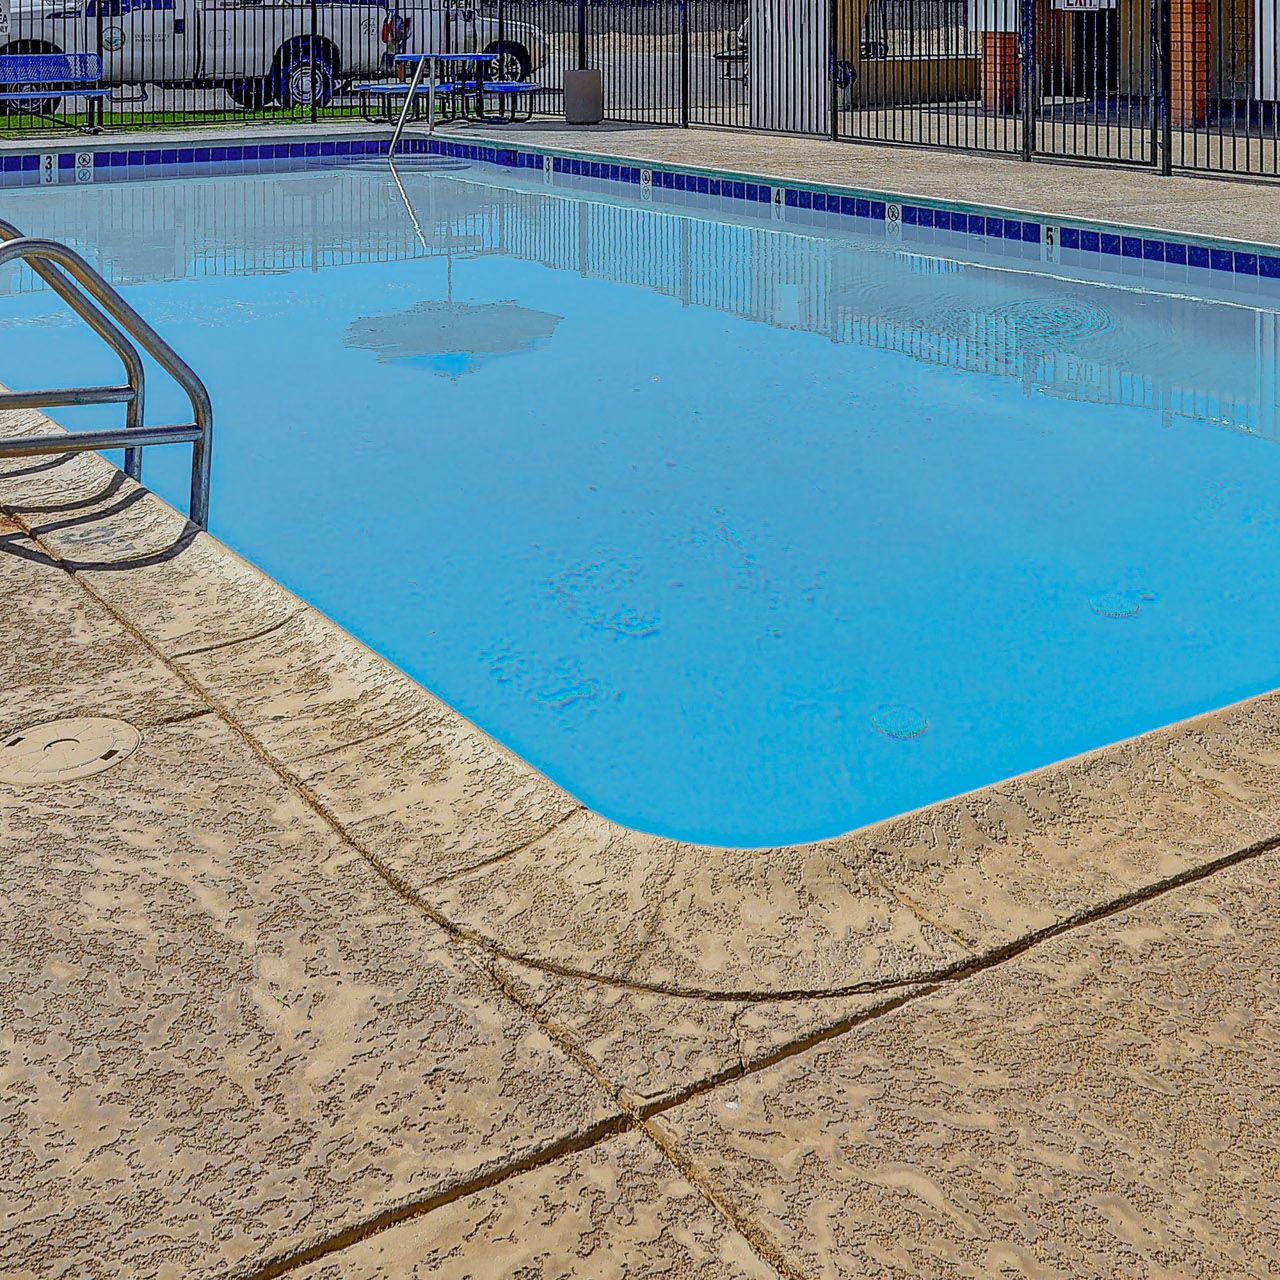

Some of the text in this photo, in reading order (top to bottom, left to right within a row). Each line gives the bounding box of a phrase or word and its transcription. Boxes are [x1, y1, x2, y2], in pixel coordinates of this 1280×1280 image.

[45, 155, 52, 170] 3
[545, 157, 551, 171] 3
[774, 188, 781, 204] 4
[1045, 226, 1054, 246] 5
